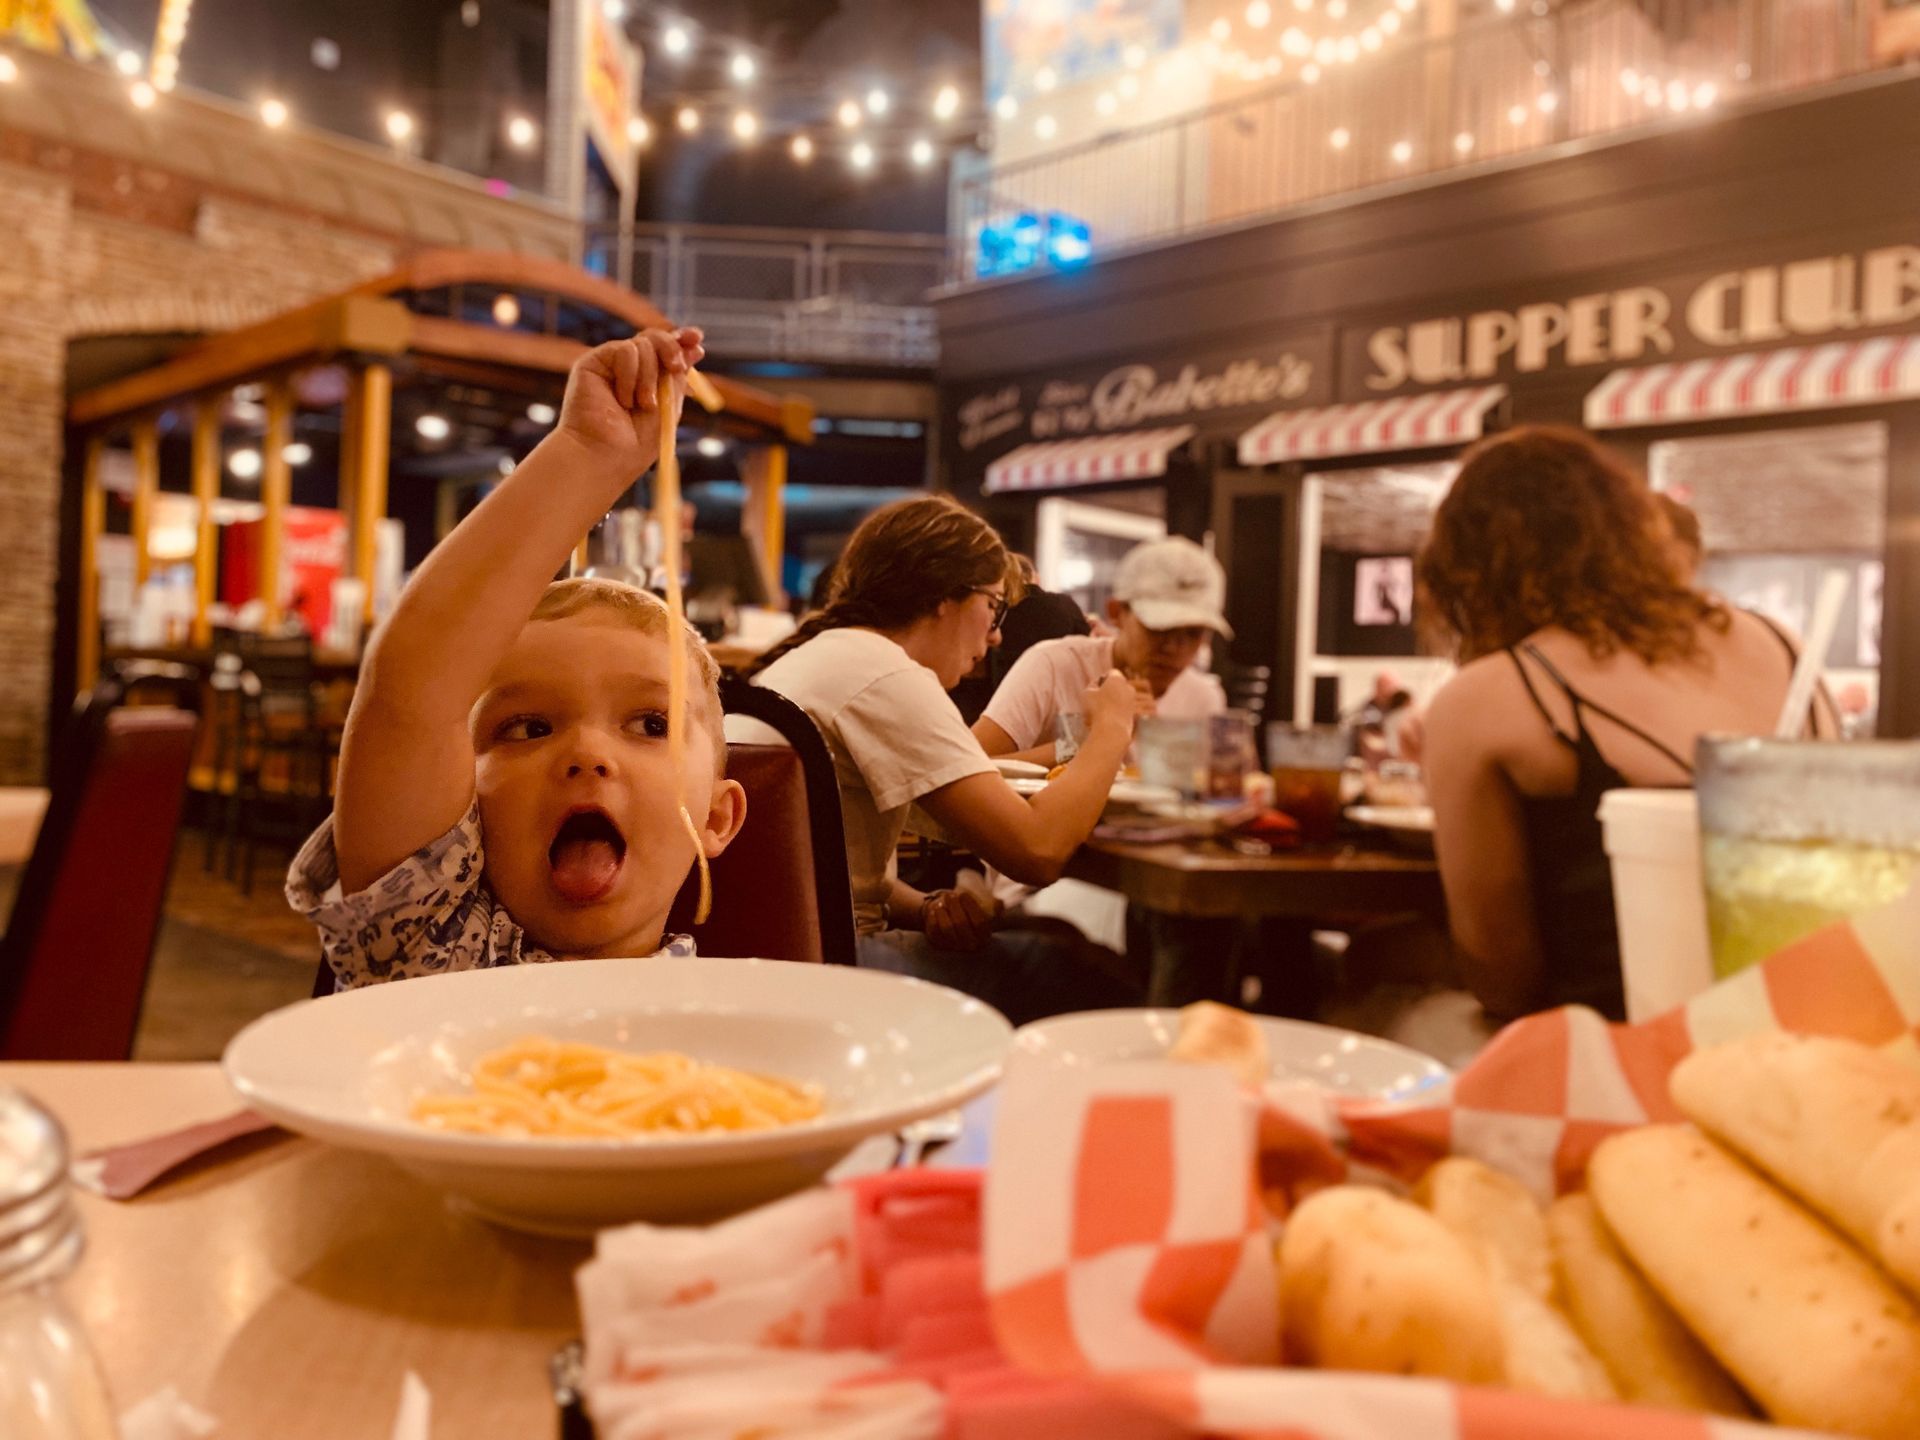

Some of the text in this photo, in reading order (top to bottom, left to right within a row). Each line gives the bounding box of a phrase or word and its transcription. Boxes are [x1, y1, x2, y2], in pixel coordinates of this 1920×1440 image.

[1365, 245, 1920, 389] SUPPER CLUB
[1091, 353, 1313, 429] Babette's
